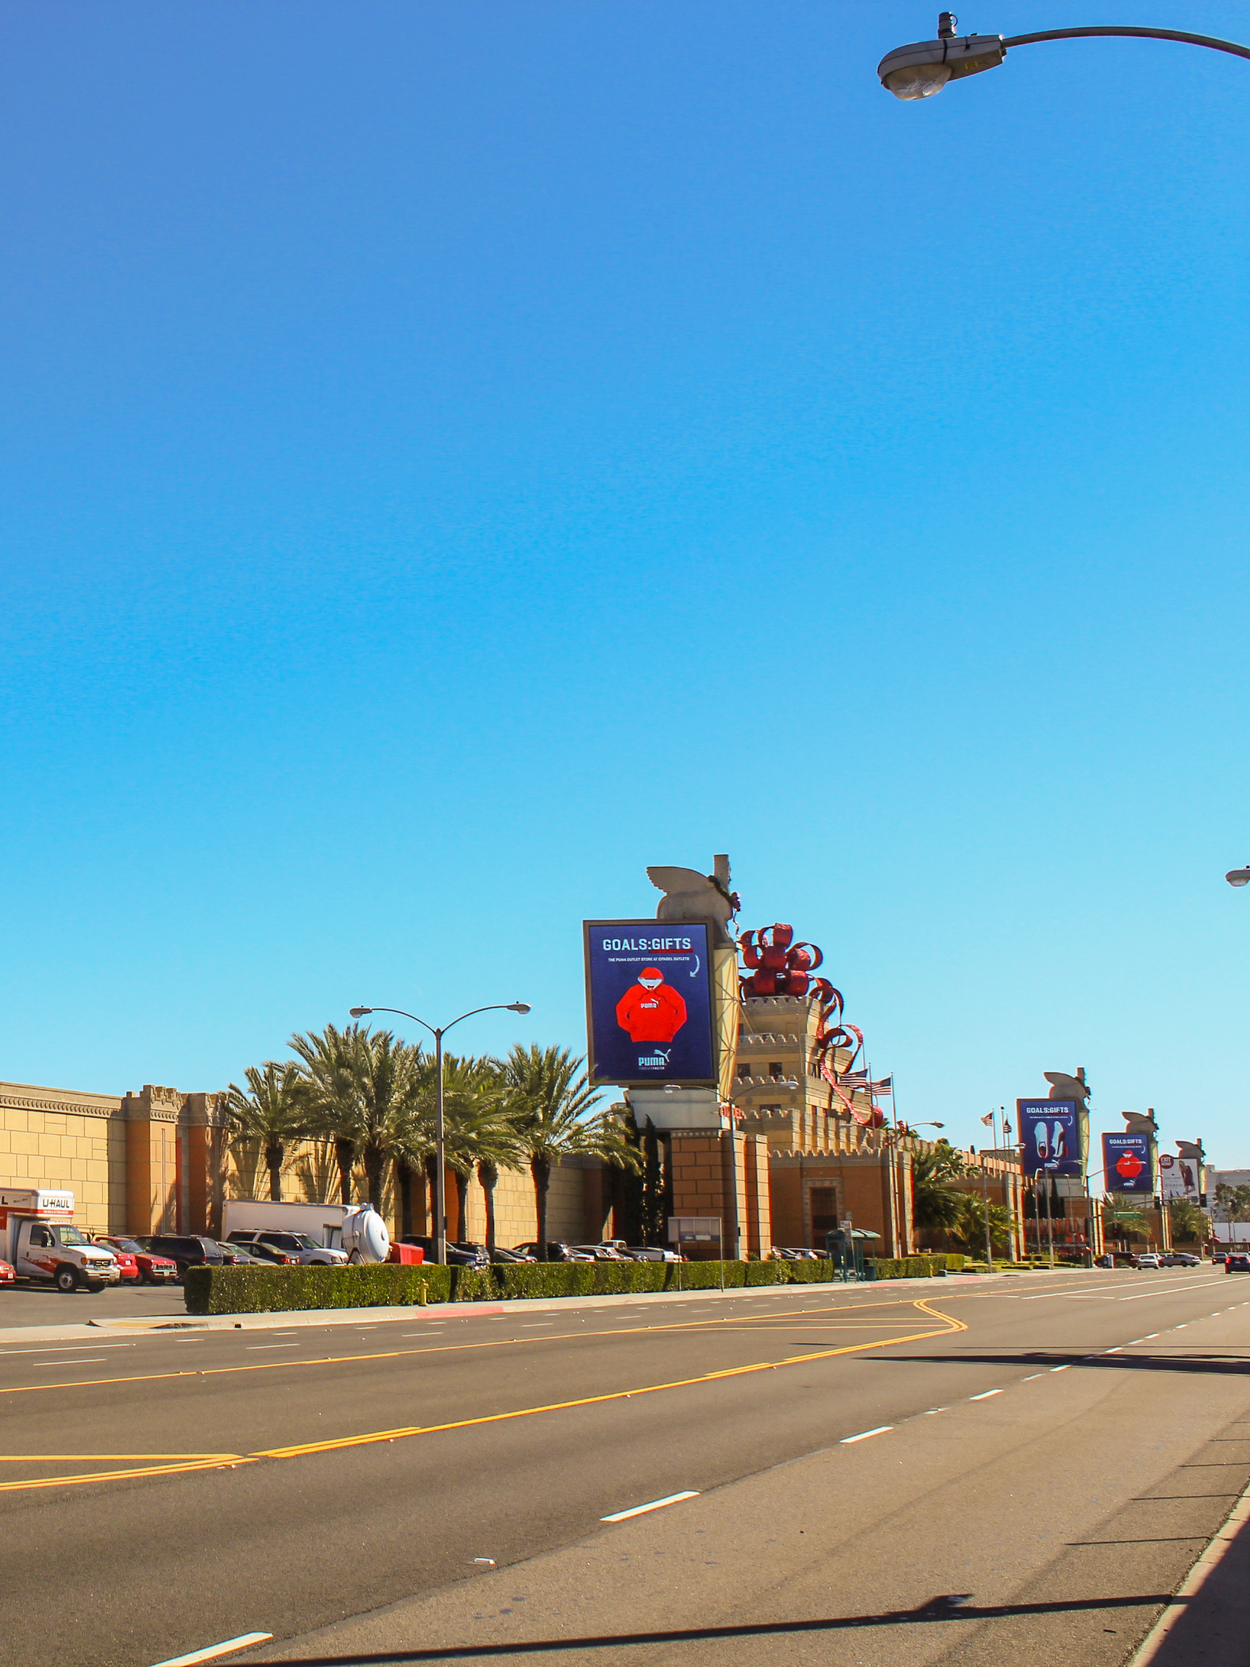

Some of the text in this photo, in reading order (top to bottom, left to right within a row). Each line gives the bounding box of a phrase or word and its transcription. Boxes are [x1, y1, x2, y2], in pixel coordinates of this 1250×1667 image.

[602, 937, 691, 951] GOALS:GIFTS
[638, 1056, 665, 1066] PUMA
[42, 1198, 70, 1208] U-HAUL
